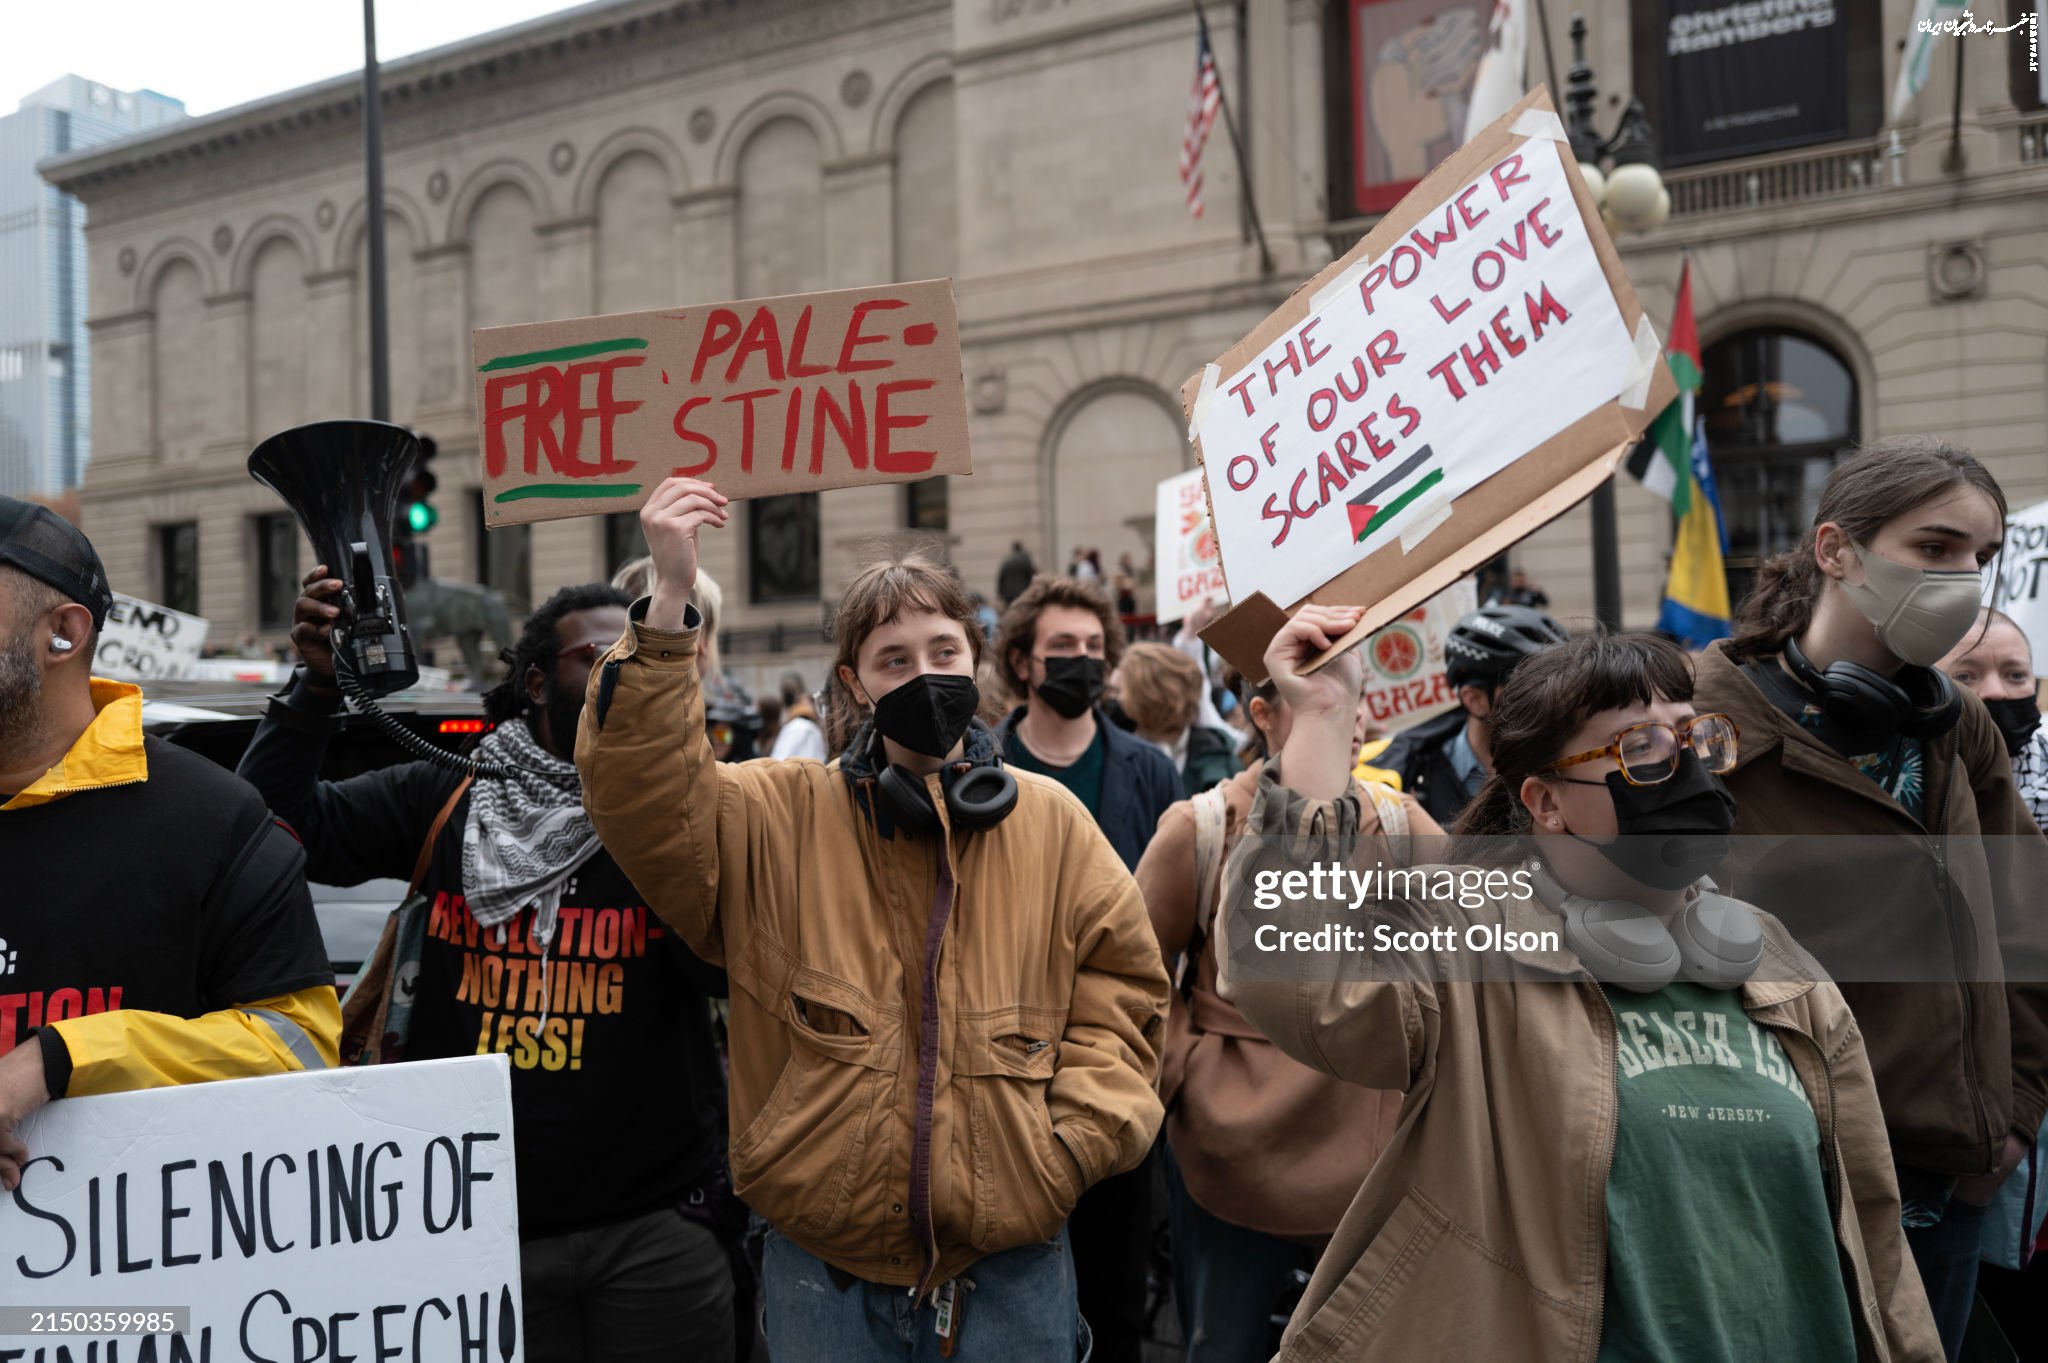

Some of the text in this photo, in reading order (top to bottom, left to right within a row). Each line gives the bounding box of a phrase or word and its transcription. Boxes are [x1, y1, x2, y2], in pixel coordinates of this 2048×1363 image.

[1229, 155, 1530, 417] THE POWER
[1227, 198, 1563, 492] OF OUR LOVE
[484, 356, 647, 479] FREE
[671, 379, 939, 479] STINE
[1262, 281, 1573, 548] SCARES THEM
[456, 951, 624, 1015] NOTHING
[476, 1011, 586, 1072] LESS!
[1615, 1011, 1814, 1112] BEACH ISL
[1669, 1104, 1764, 1123] NEW JERSEY
[13, 1131, 501, 1279] SILENCING OF
